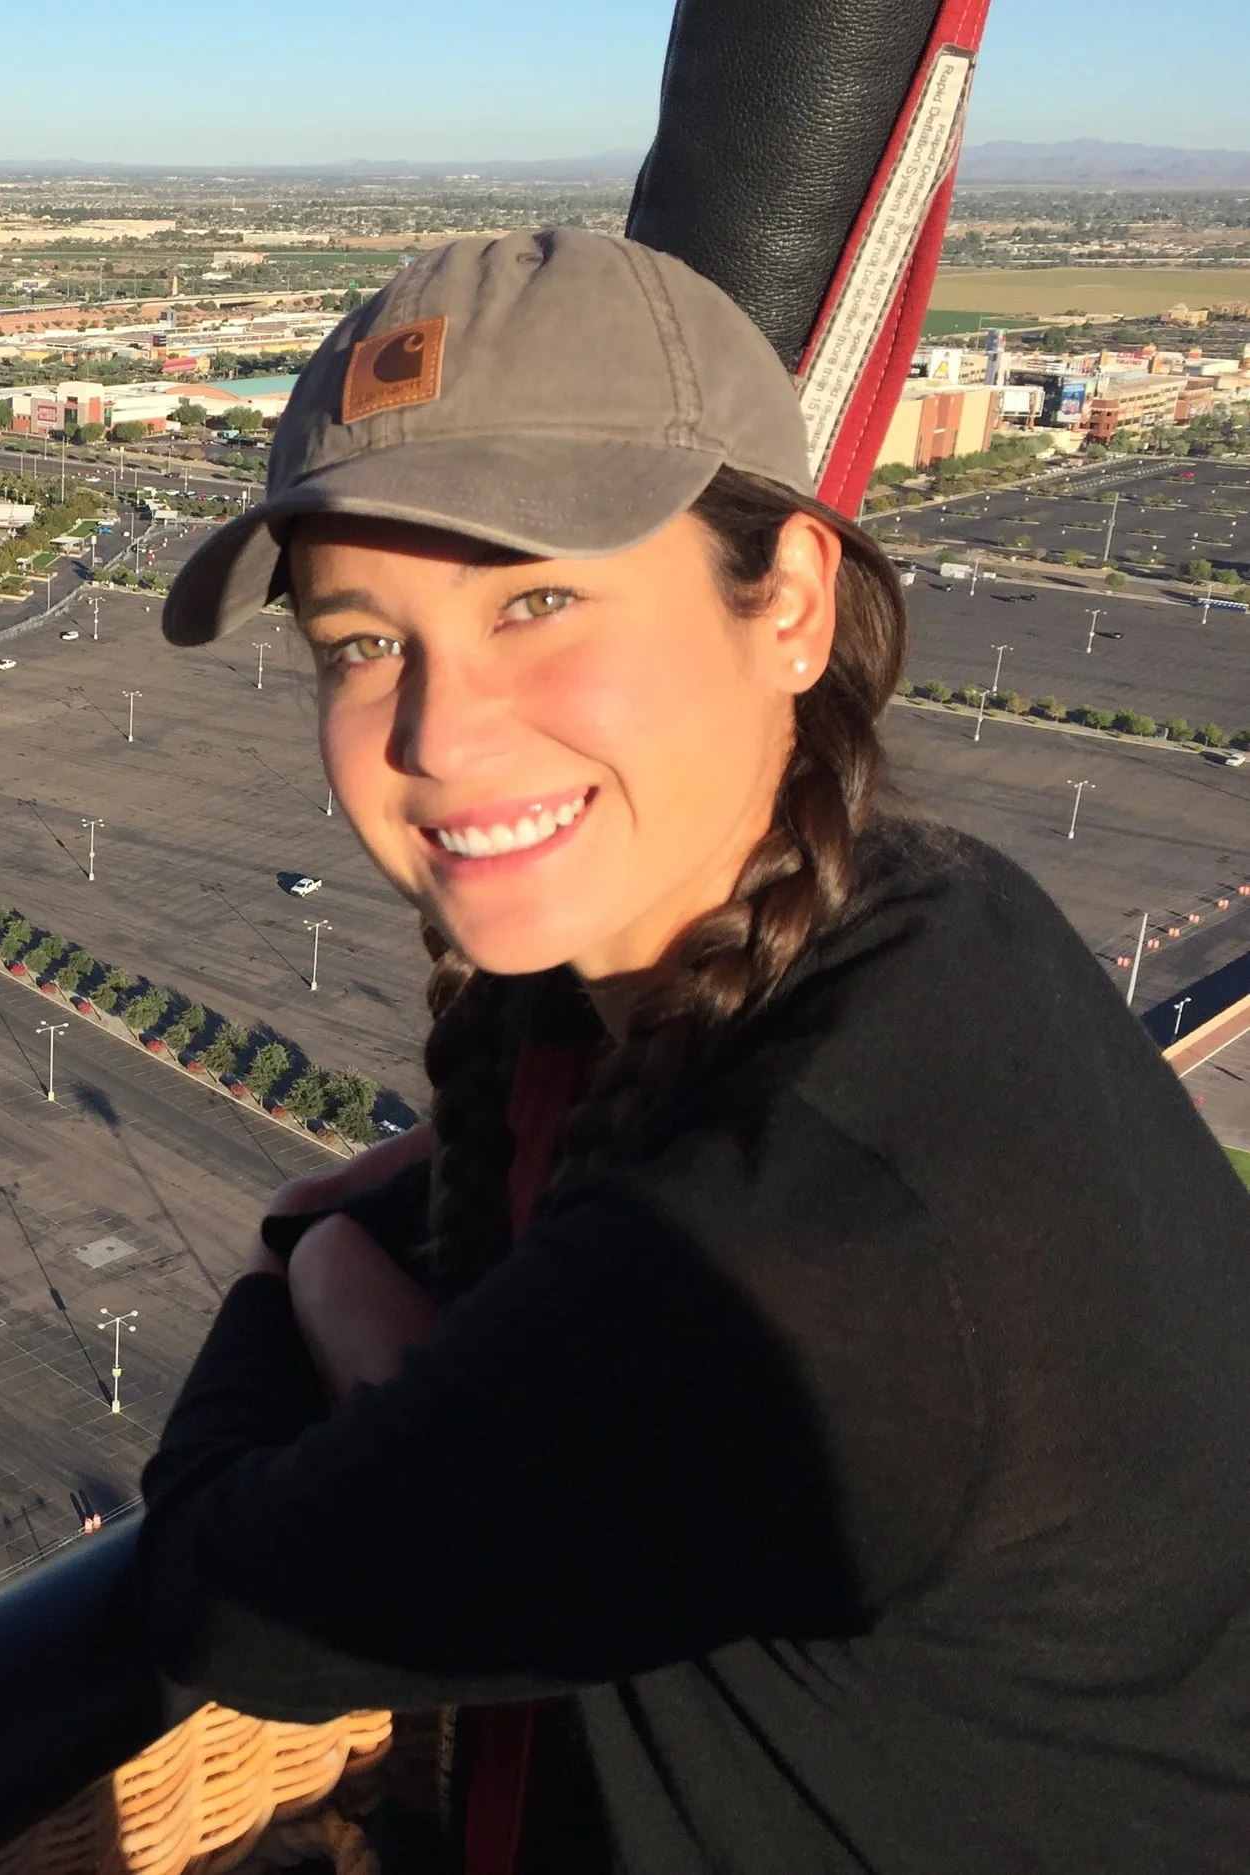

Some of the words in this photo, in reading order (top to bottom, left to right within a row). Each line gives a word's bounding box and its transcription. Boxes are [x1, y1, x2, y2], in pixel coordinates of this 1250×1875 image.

[932, 64, 954, 102] Rapid
[911, 106, 940, 162] Deflation
[927, 123, 946, 162] Rapid
[902, 163, 931, 218] Deflation
[875, 214, 895, 245] must
[866, 247, 881, 267] not
[867, 270, 888, 309] MUST
[827, 335, 846, 365] more
[815, 367, 833, 392] than
[805, 413, 815, 421] ft
[807, 397, 821, 410] 15
